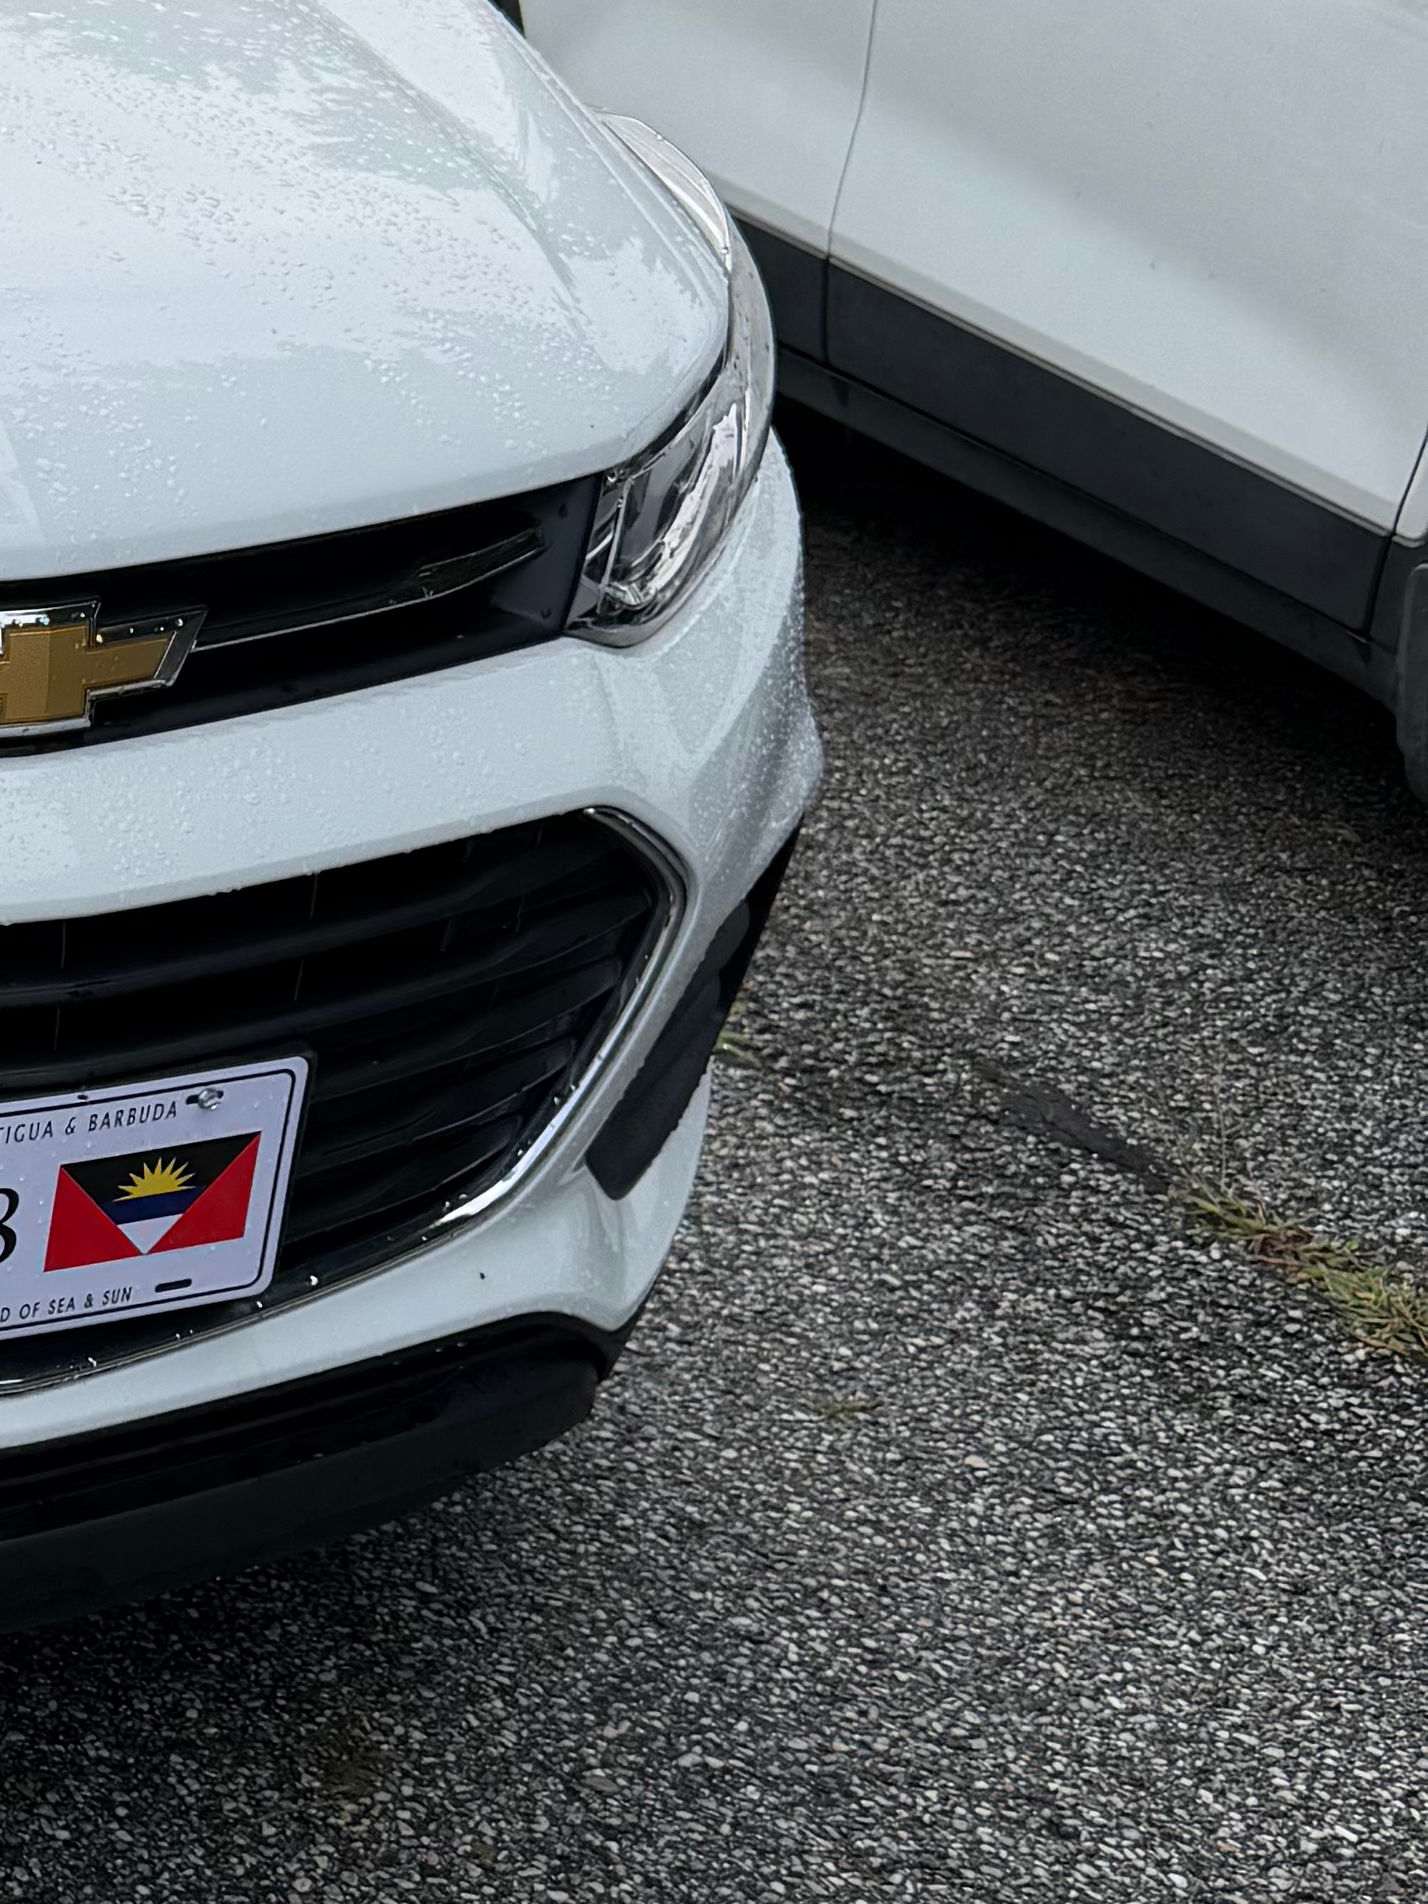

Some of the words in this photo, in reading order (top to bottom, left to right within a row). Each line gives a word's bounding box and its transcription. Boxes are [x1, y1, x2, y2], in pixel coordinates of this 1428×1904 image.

[64, 1116, 77, 1136] &
[87, 1100, 178, 1133] BARBUDA
[18, 1300, 41, 1320] OF
[47, 1296, 76, 1315] SEA
[83, 1293, 94, 1309] &
[101, 1286, 133, 1306] SUN
